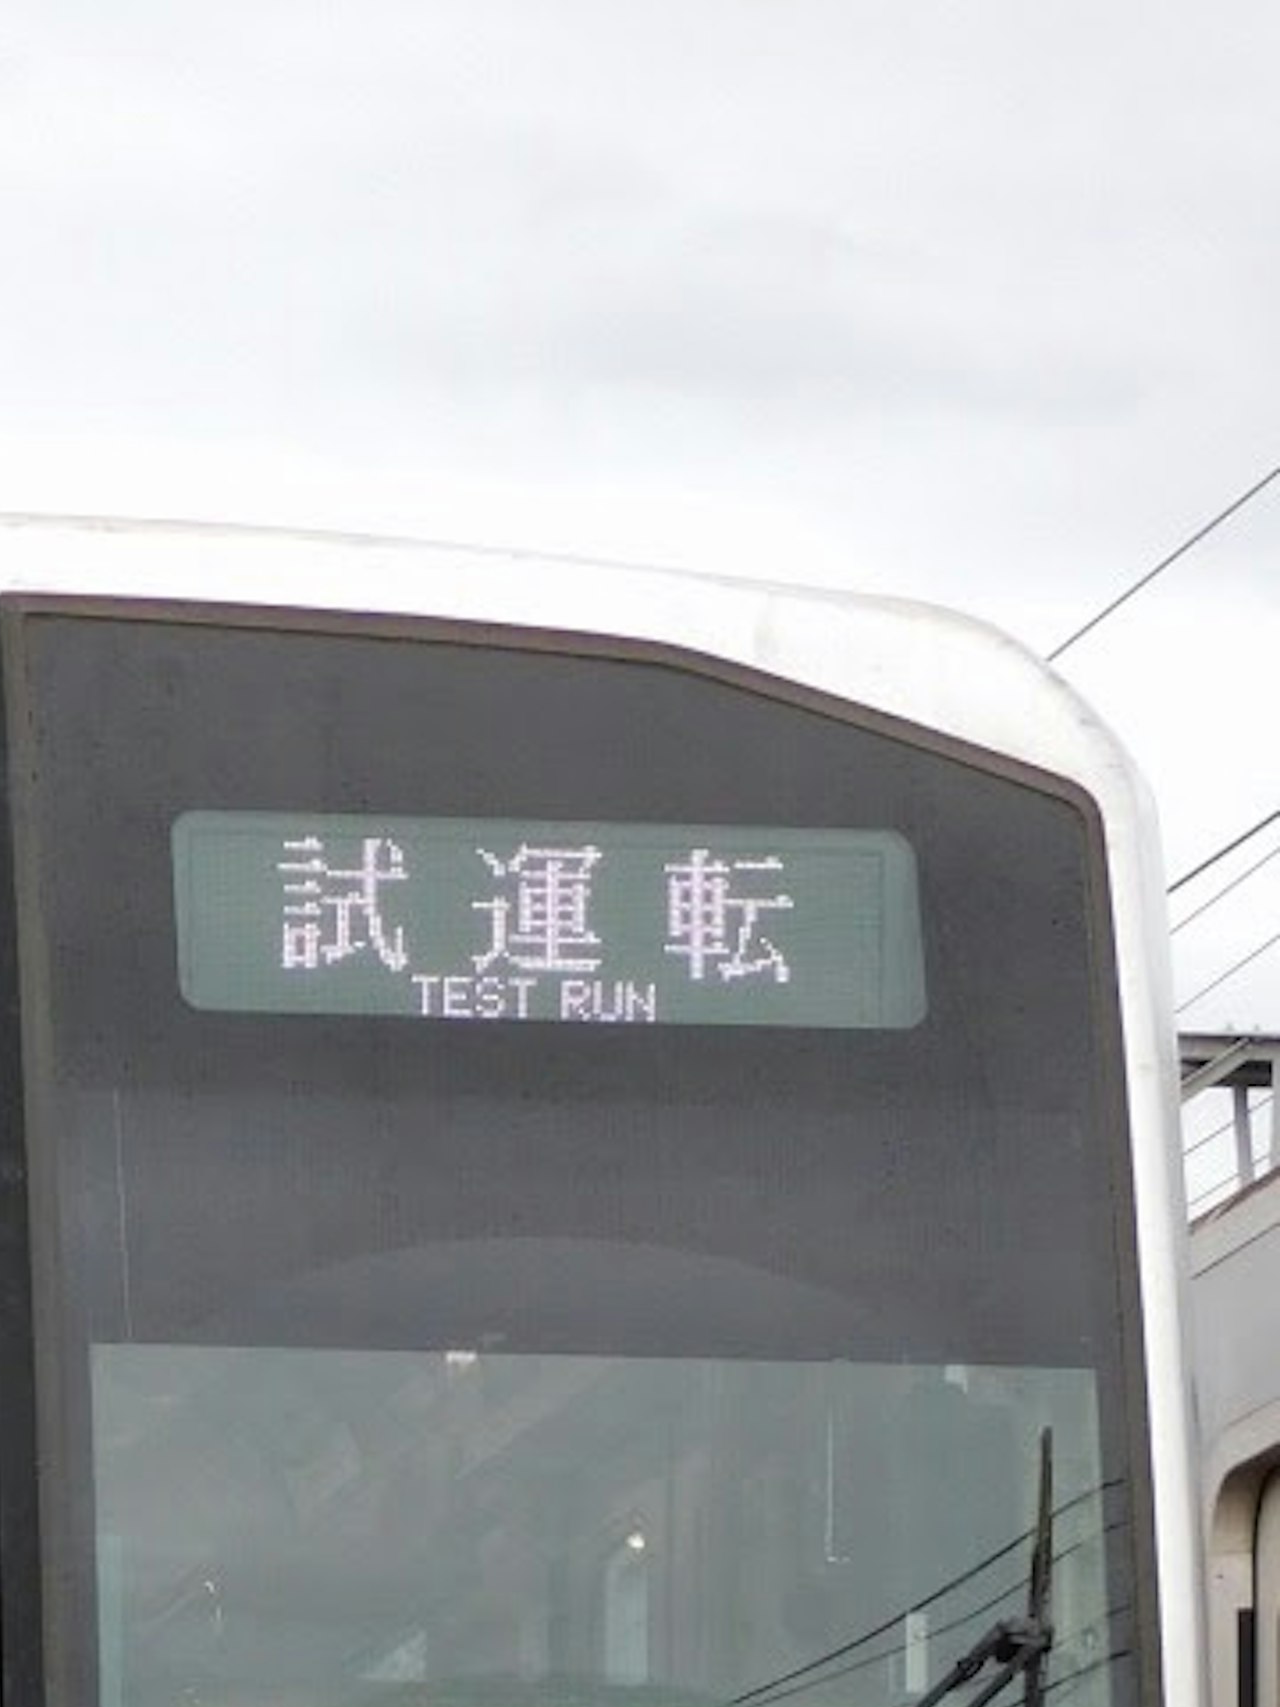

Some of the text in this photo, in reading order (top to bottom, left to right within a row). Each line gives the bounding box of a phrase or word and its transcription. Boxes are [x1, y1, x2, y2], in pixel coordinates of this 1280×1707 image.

[276, 835, 795, 983] 試運転
[411, 974, 656, 1023] TEST RUN
